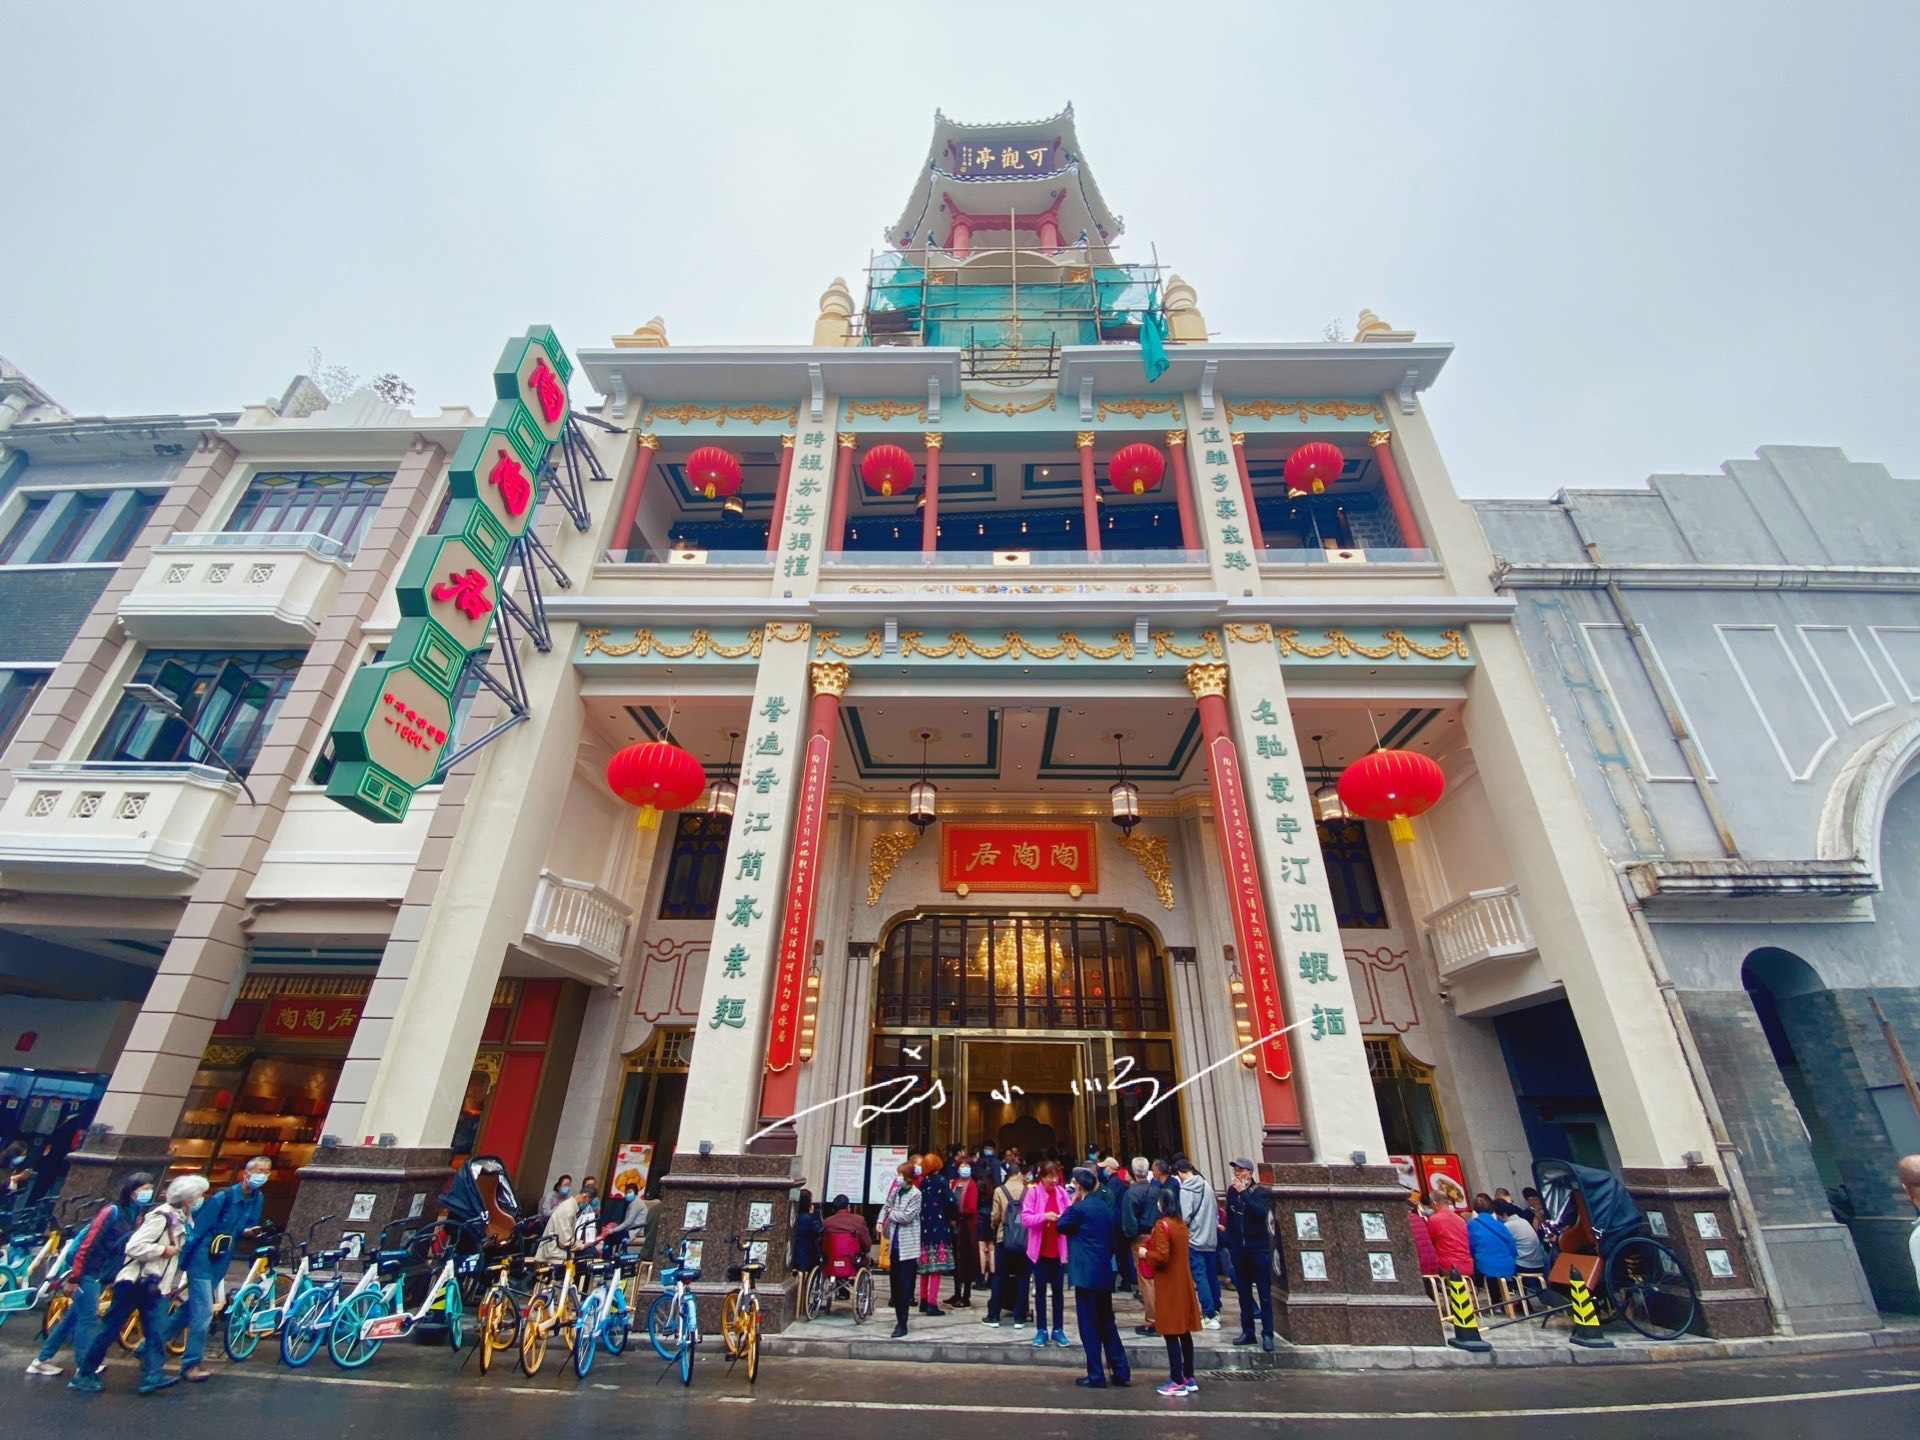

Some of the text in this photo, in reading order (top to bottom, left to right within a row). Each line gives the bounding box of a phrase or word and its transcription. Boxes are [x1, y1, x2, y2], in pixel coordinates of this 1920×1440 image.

[975, 146, 1048, 170] 可觀亭
[965, 842, 1079, 871] 陶陶居
[277, 1006, 357, 1031] 陶陶居
